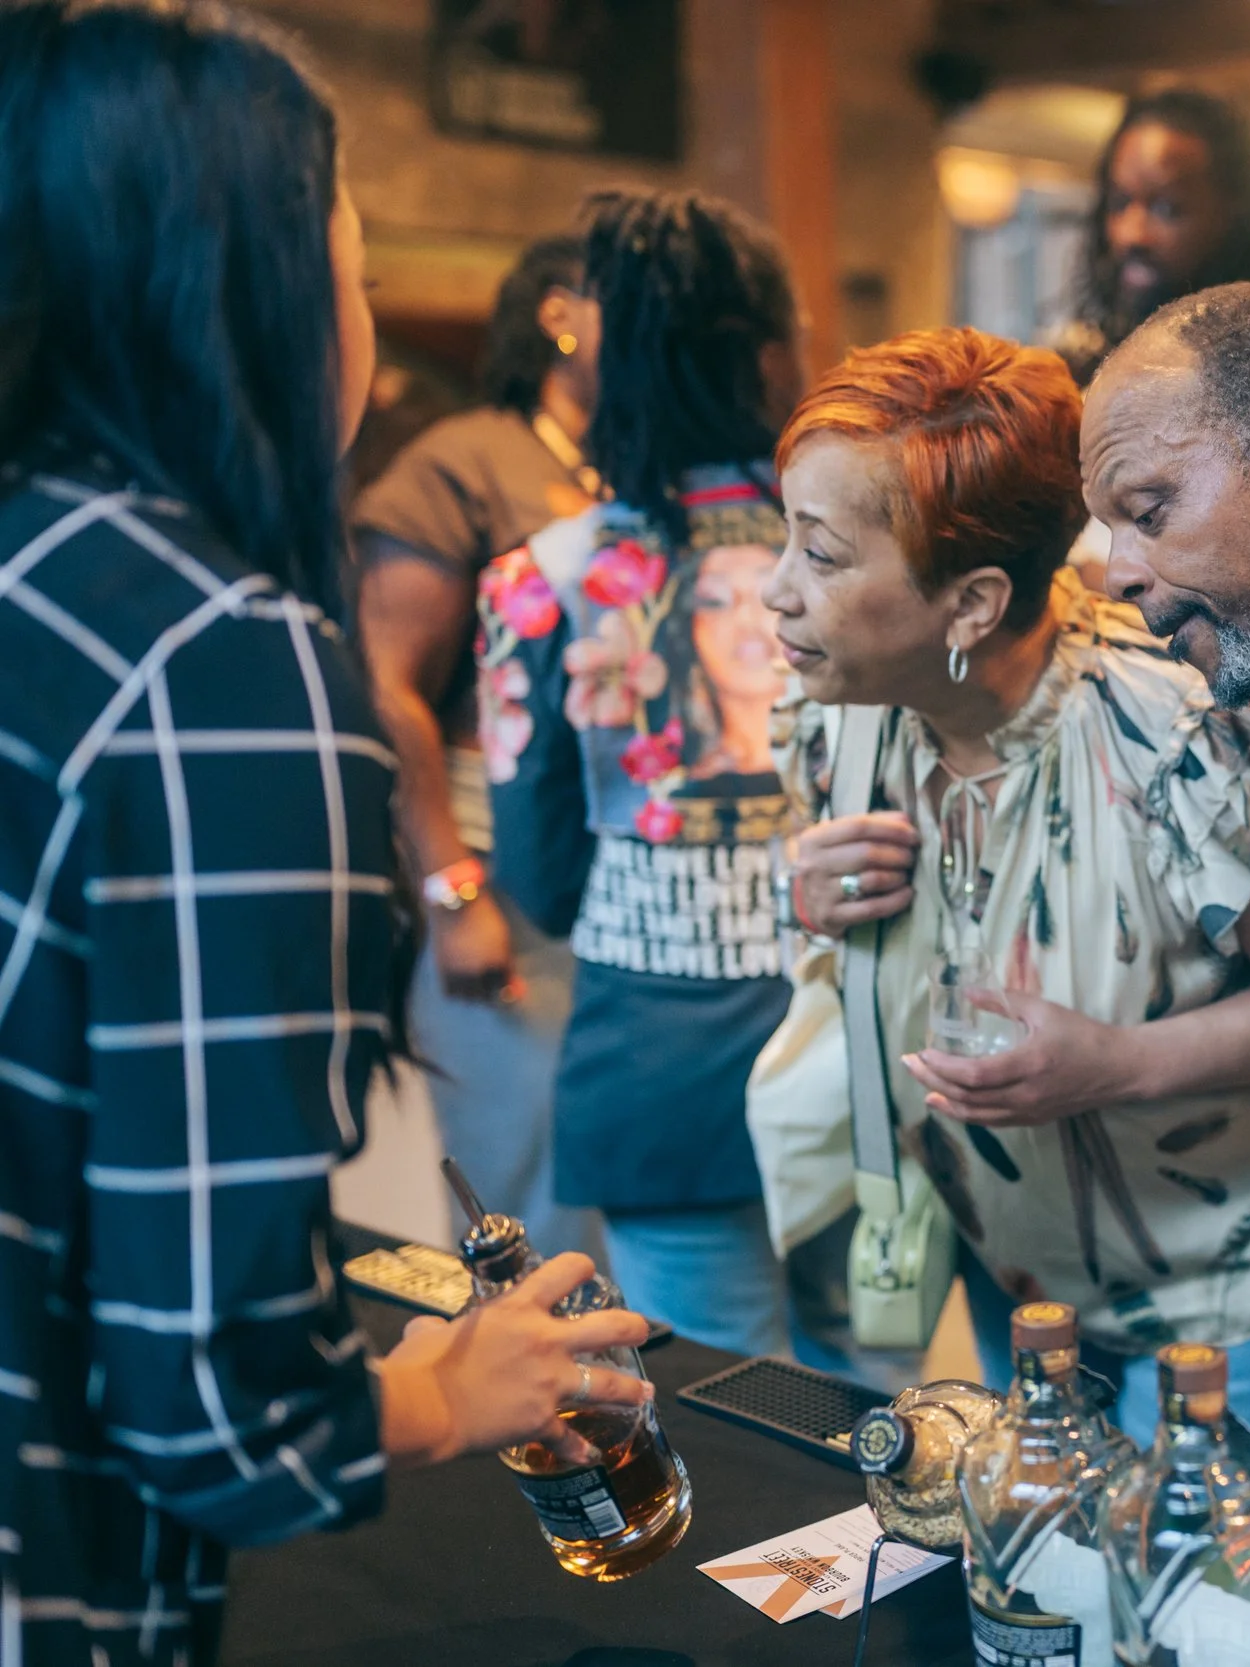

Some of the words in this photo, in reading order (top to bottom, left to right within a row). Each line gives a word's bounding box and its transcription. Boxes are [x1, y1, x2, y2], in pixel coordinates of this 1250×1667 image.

[791, 1546, 821, 1564] WHISKEY
[763, 1551, 837, 1594] STONESTREET
[820, 1563, 851, 1582] BOURBON
